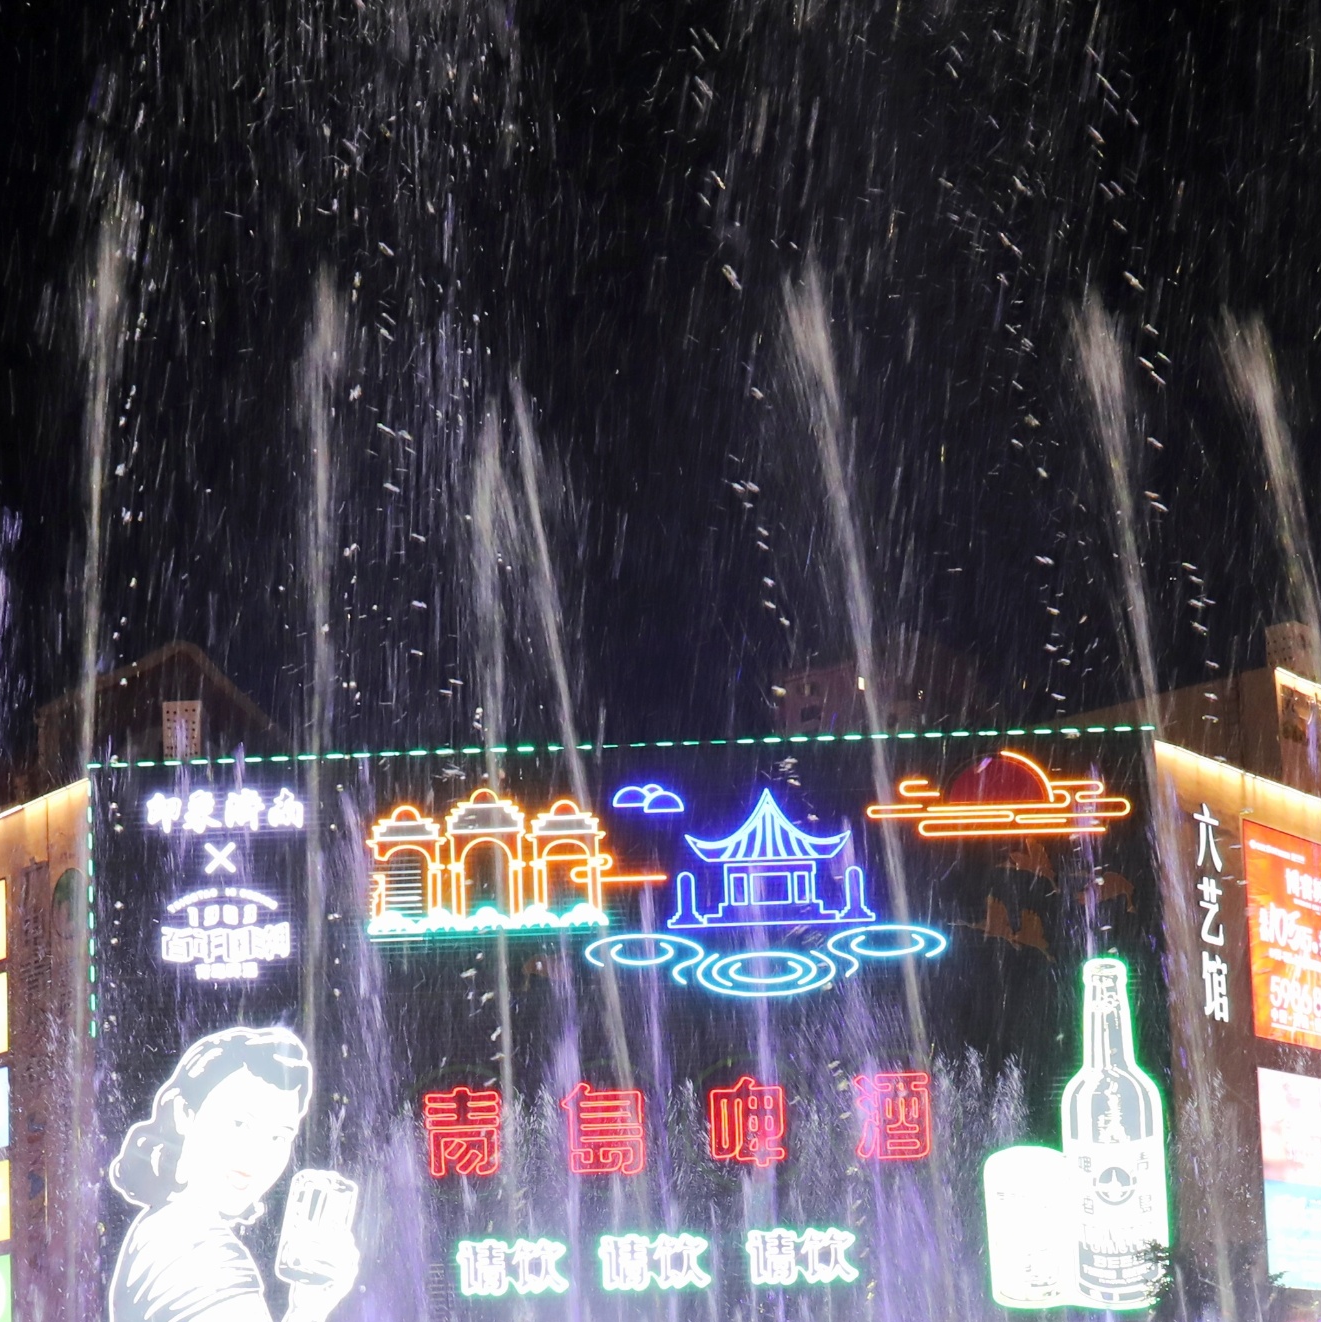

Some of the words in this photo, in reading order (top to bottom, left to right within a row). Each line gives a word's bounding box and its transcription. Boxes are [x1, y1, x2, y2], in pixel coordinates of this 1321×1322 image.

[1193, 802, 1230, 1023] 六艺馆
[457, 1238, 569, 1296] 请饮
[599, 1233, 711, 1291] 请饮
[746, 1227, 859, 1286] 请饮
